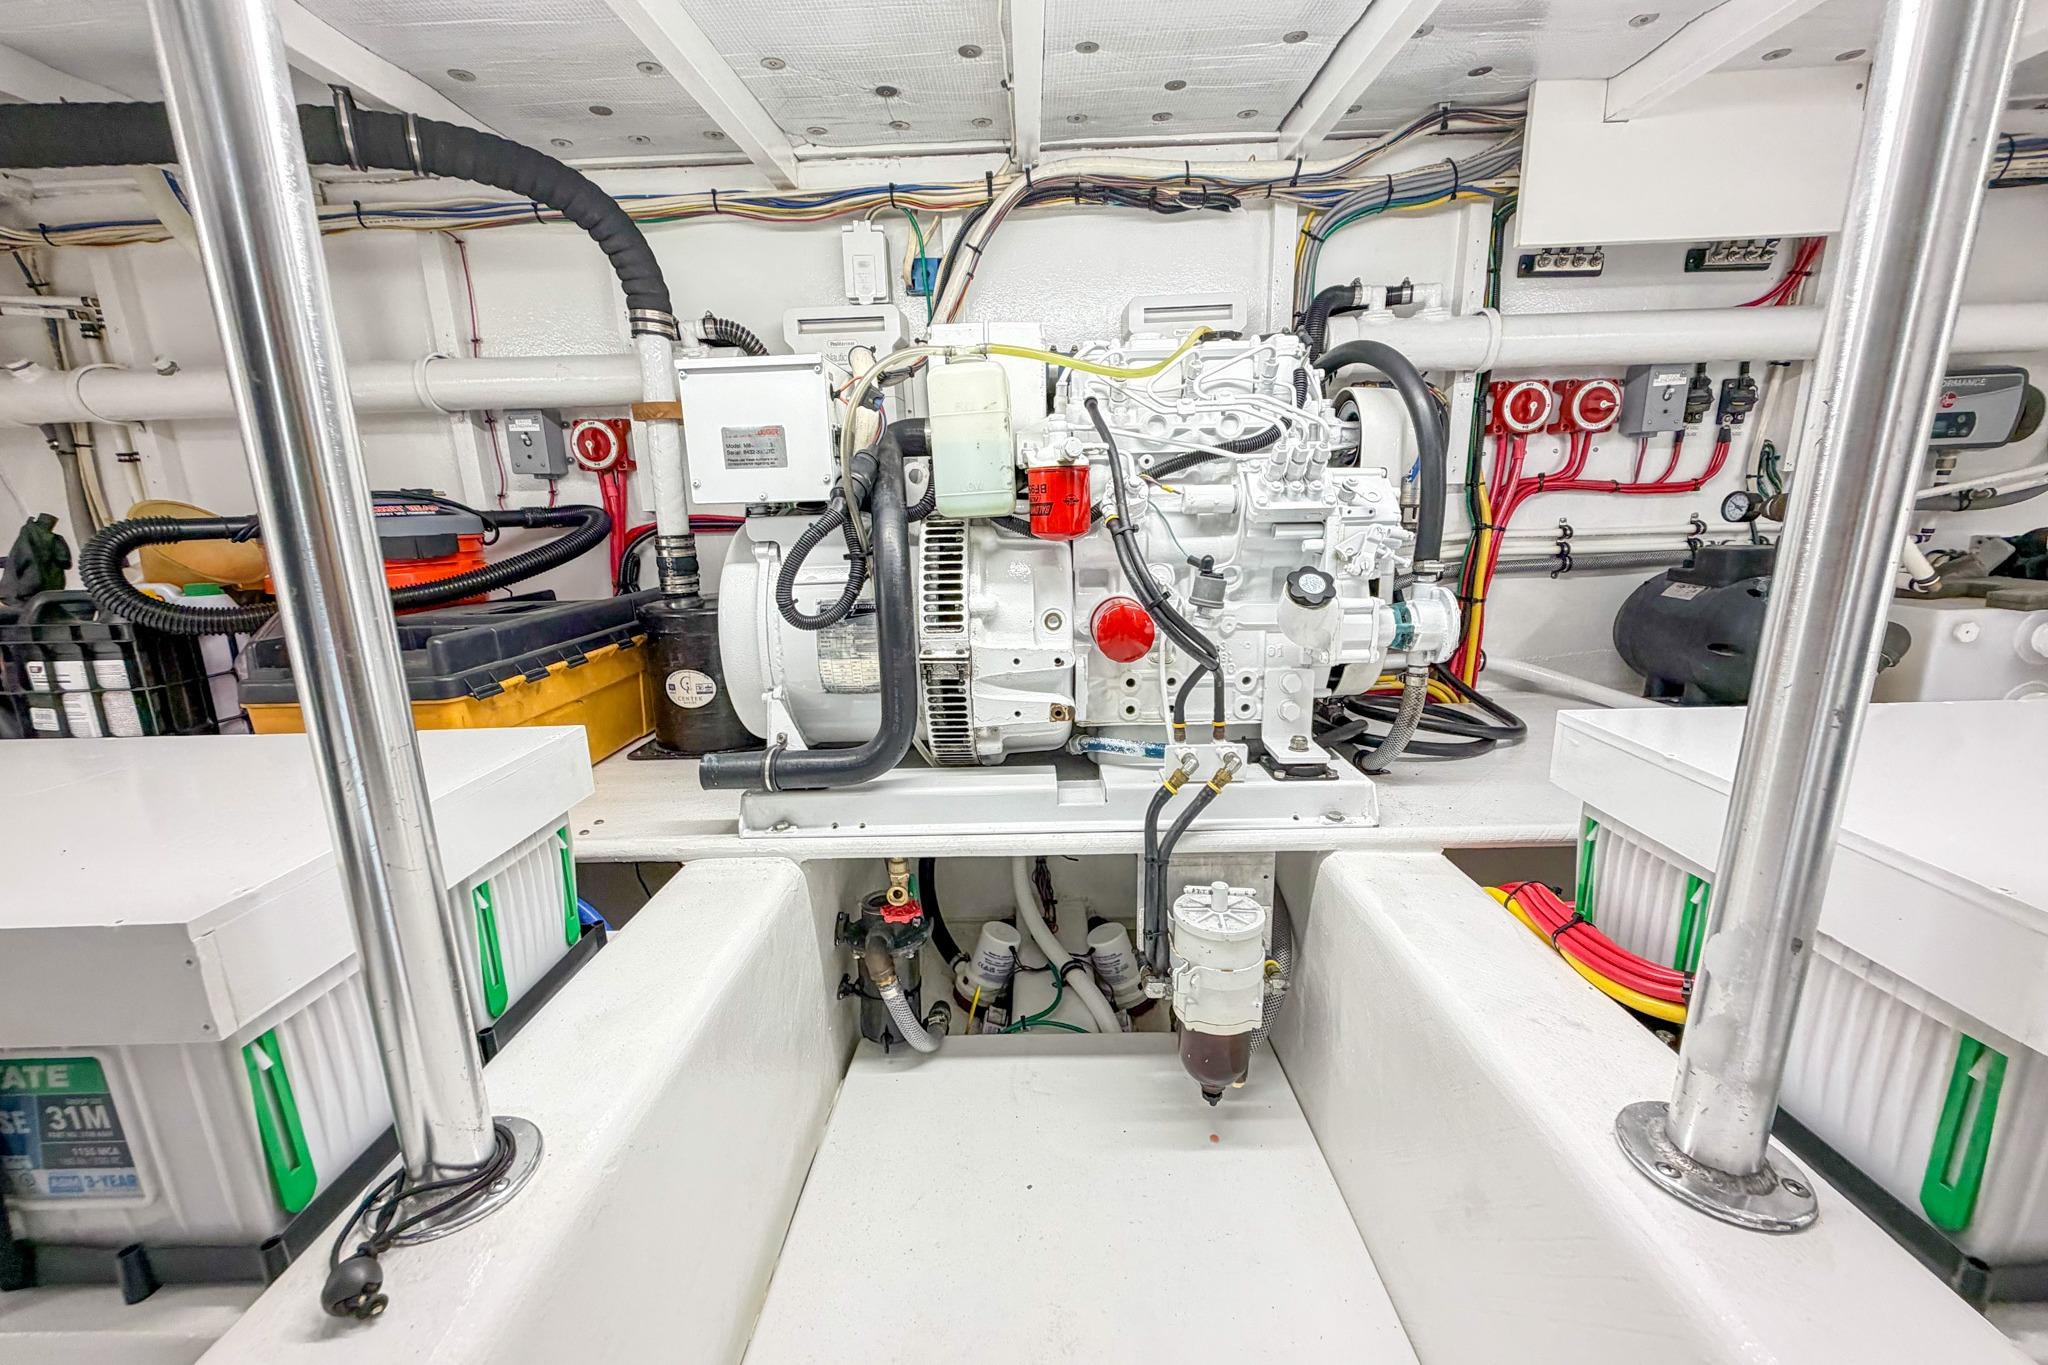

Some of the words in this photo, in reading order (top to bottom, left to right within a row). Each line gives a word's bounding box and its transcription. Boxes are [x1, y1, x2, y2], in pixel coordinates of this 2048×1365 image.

[1942, 378, 1985, 387] ORMANCE
[0, 1064, 70, 1089] ATE
[45, 1105, 112, 1130] 31M
